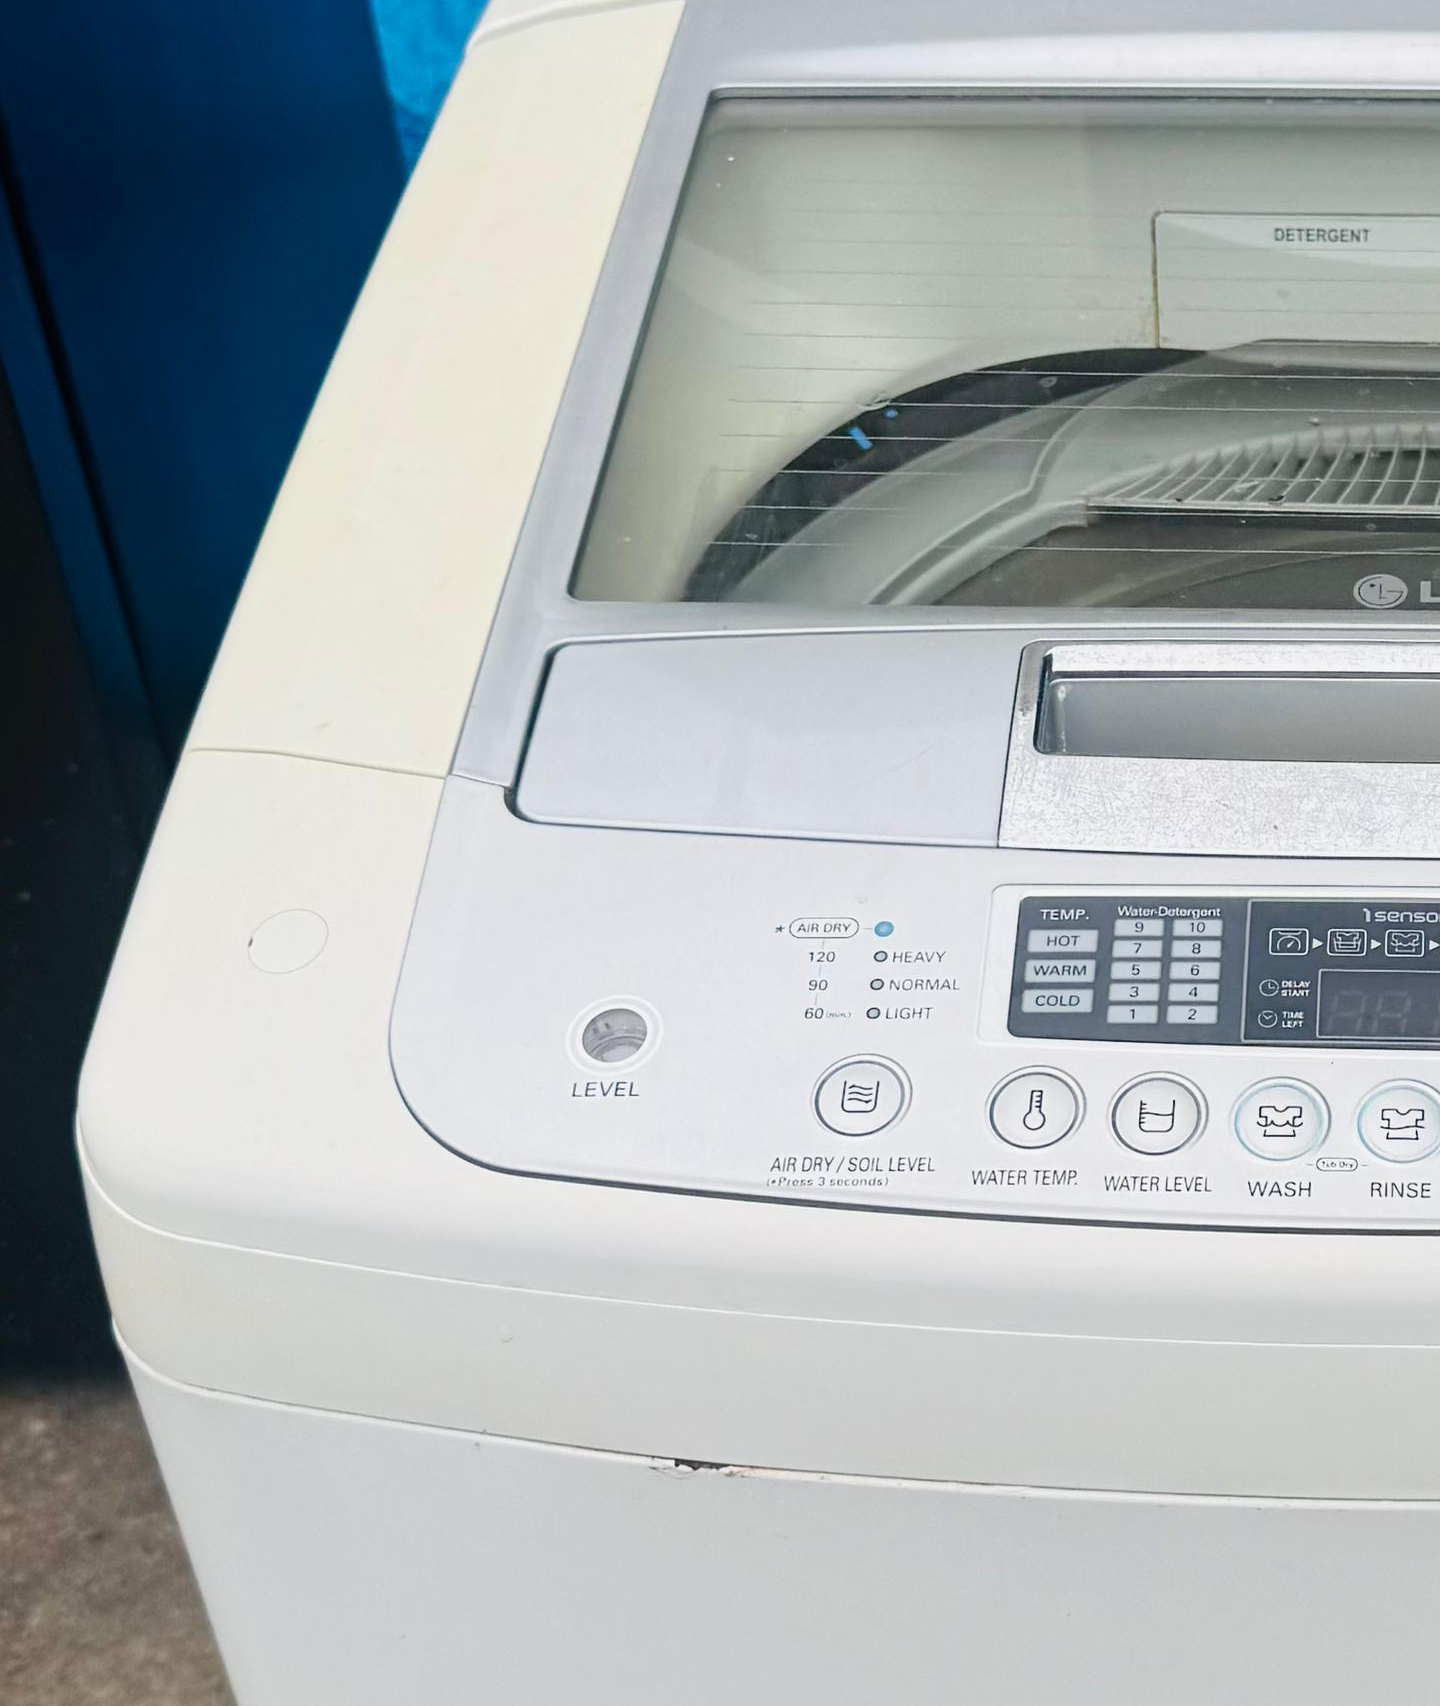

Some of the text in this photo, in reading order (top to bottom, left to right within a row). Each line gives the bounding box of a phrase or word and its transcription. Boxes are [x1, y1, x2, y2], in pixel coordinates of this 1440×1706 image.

[1274, 228, 1370, 243] DETERGENT
[1040, 909, 1090, 920] TEMP.
[797, 922, 852, 934] AIR DRY
[1134, 921, 1144, 933] 9
[1190, 921, 1206, 934] 10
[1046, 934, 1080, 947] HOT
[1133, 943, 1142, 954] 7
[1191, 943, 1201, 955] 8
[807, 950, 836, 963] 120
[892, 951, 946, 963] HEAVY
[1033, 964, 1087, 977] WARM
[1131, 964, 1141, 976] 5
[1190, 964, 1200, 976] 6
[808, 979, 828, 991] 90
[889, 978, 960, 992] NORMAL
[1130, 986, 1139, 998] 3
[1188, 986, 1198, 998] 4
[1035, 995, 1081, 1007] COLD
[885, 1006, 934, 1020] LIGHT
[1129, 1008, 1136, 1020] 1
[1187, 1008, 1197, 1021] 2
[571, 1082, 640, 1098] LEVEL
[770, 1156, 798, 1173] AIR
[801, 1156, 834, 1173] DRY
[847, 1156, 884, 1173] SOIL
[888, 1156, 935, 1173] LEVEL
[817, 1176, 826, 1187] 3
[971, 1169, 1079, 1187] WATER TEMP.
[1104, 1175, 1212, 1194] WATER LEVEL
[1247, 1181, 1312, 1198] WASH
[1370, 1181, 1431, 1198] RINSE
